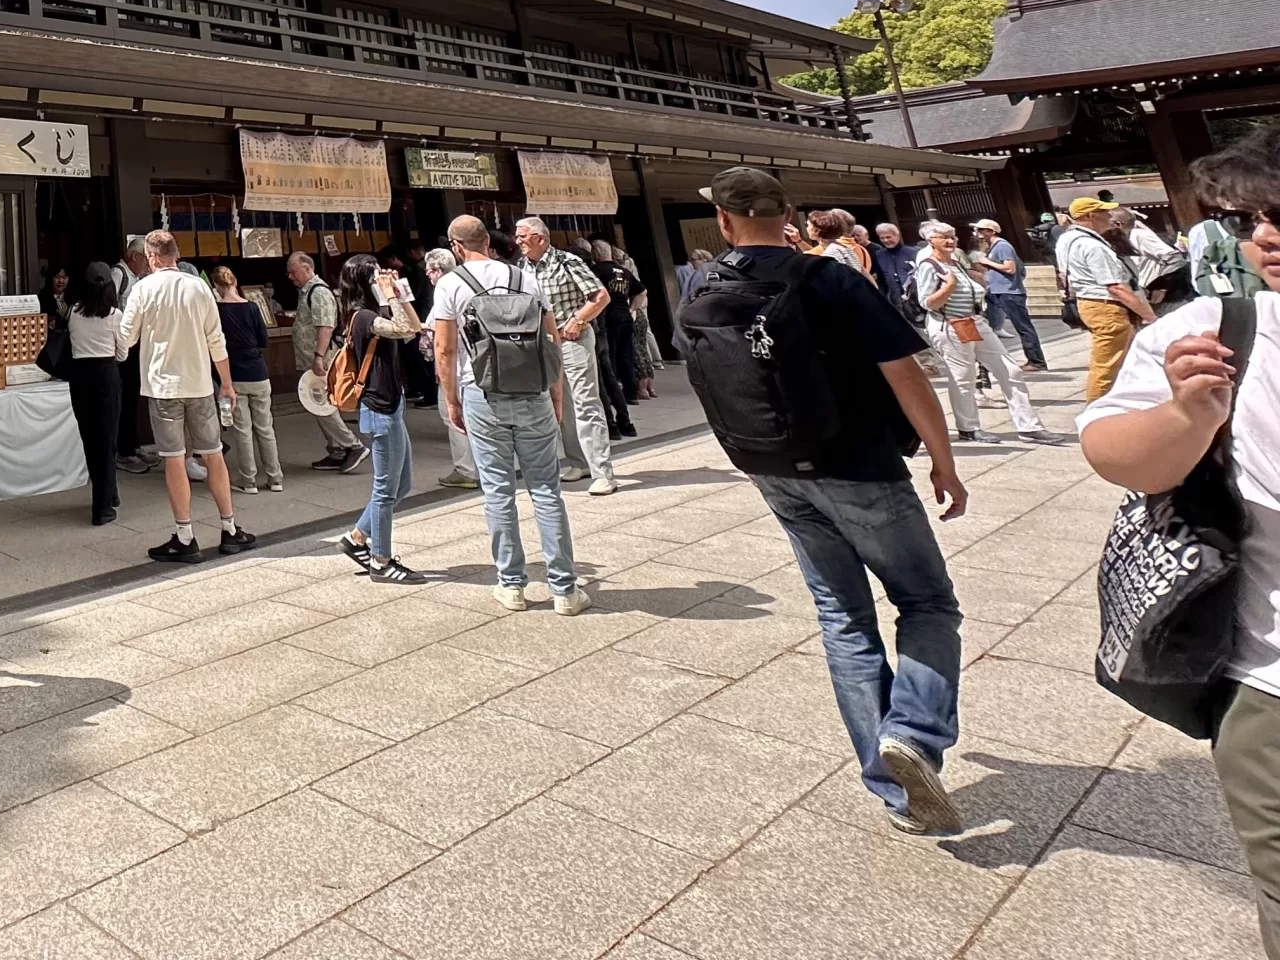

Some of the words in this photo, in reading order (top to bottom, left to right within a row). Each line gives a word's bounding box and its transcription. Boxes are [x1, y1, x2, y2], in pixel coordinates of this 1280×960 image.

[433, 174, 438, 185] A
[439, 174, 459, 186] VOTIVE
[460, 175, 482, 188] TABLET
